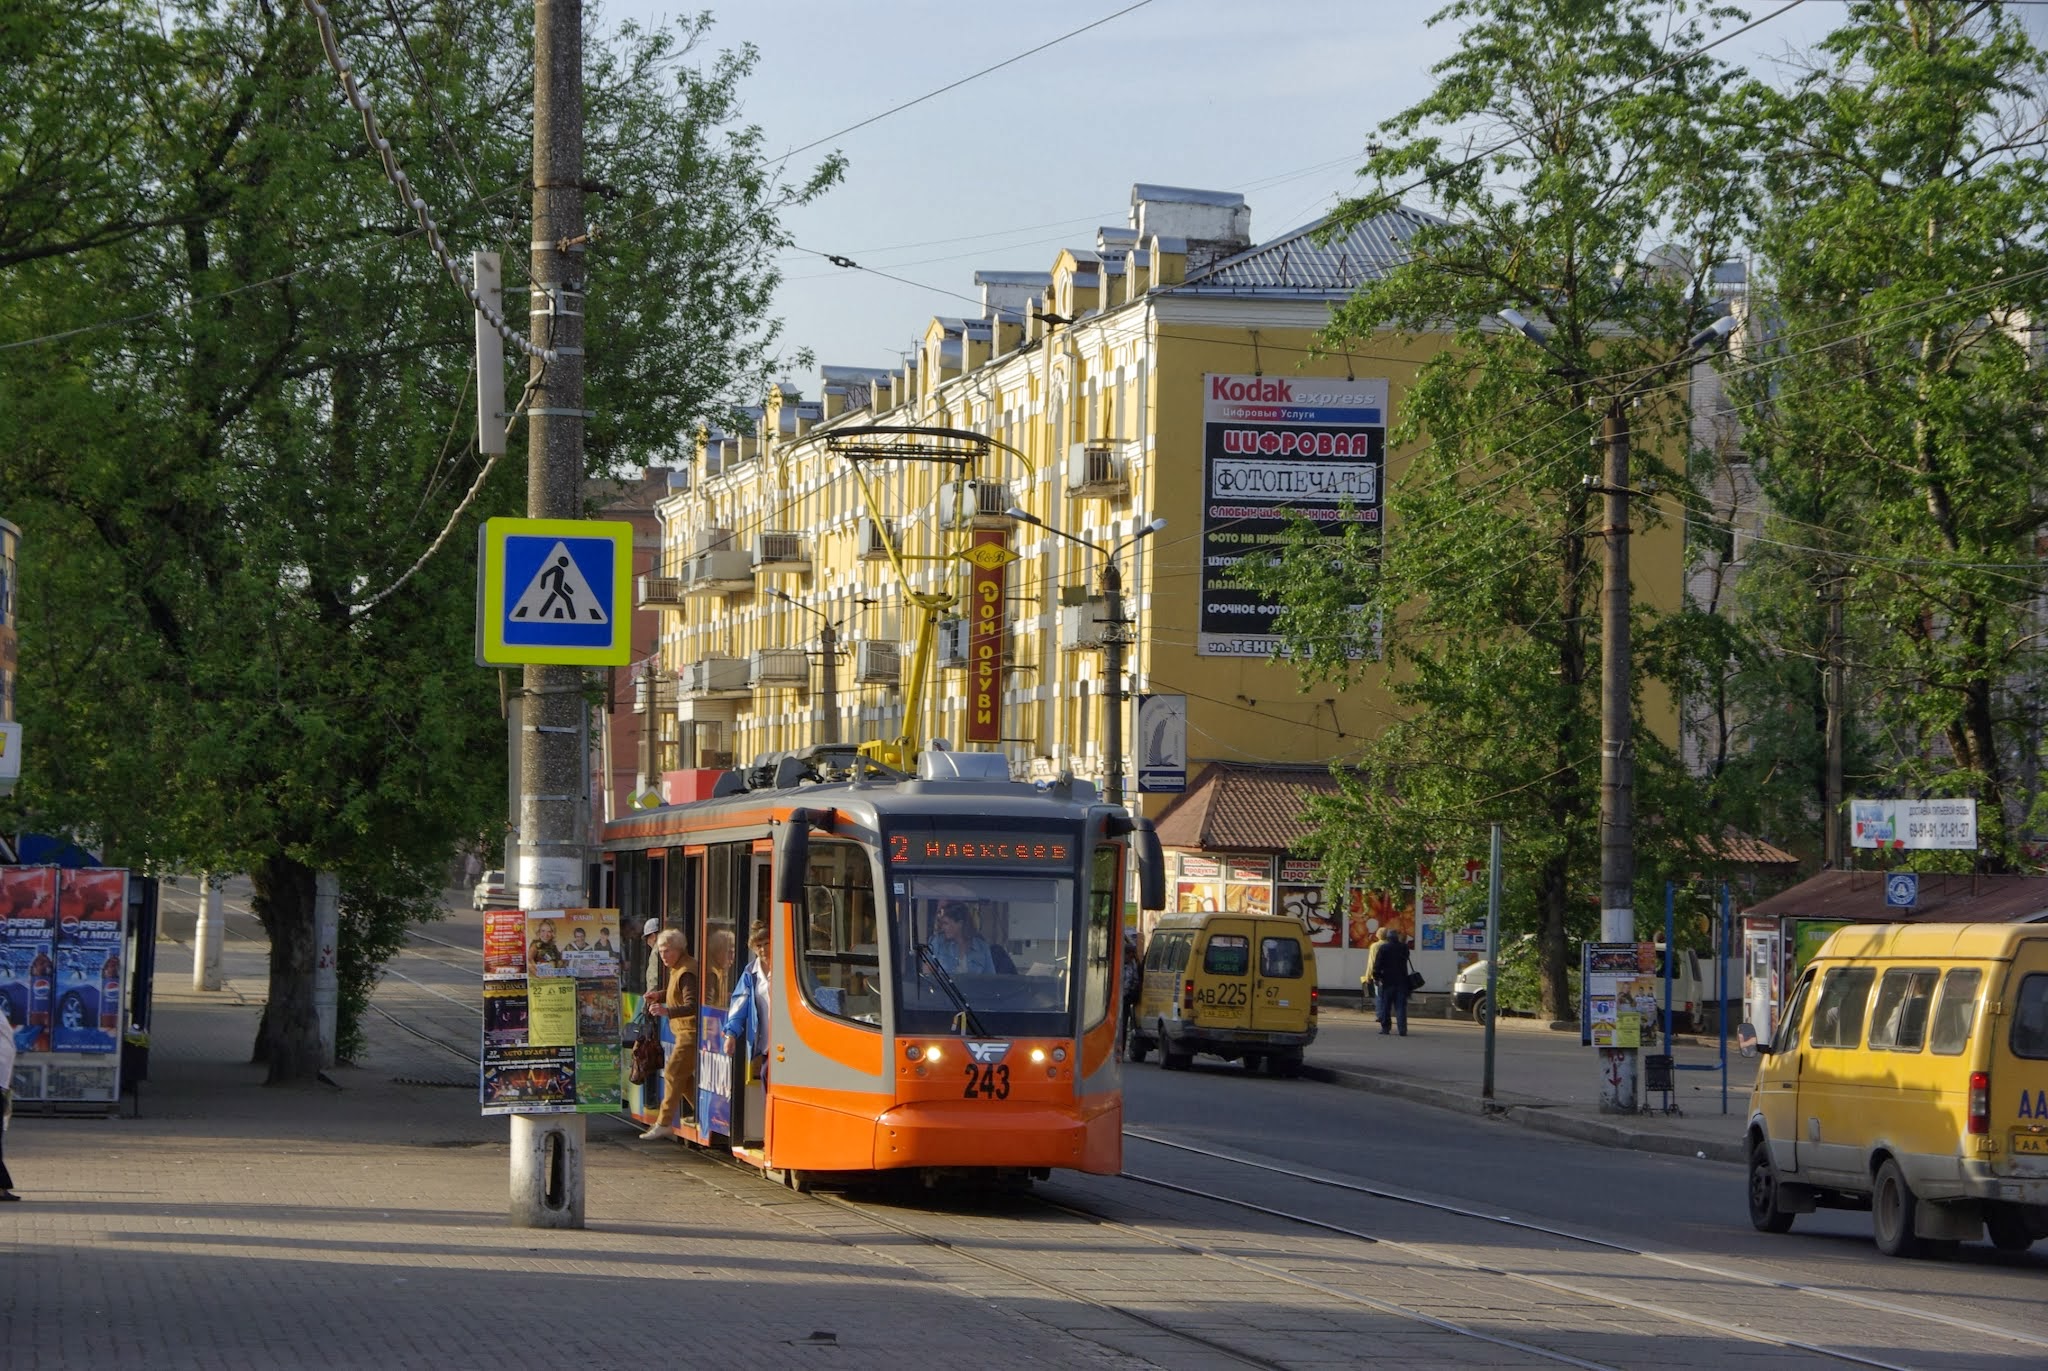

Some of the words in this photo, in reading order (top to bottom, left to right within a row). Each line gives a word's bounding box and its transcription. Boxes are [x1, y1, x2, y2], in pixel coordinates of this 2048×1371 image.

[1212, 376, 1293, 403] Kodak
[1294, 391, 1376, 406] express
[1223, 408, 1278, 420] Цифровые
[1281, 409, 1315, 421] Услуги
[1223, 430, 1368, 457] ЦИФРОВАЯ
[1218, 469, 1371, 495] ФОТОПЕЧАТЬ
[1209, 505, 1217, 518] С
[1217, 506, 1258, 519] ЛЮБЫХ
[1208, 533, 1239, 543] ФОТО
[1241, 534, 1254, 544] НА
[978, 580, 999, 636] ДОМ
[1207, 603, 1256, 614] СРОЧНОЕ
[1257, 605, 1290, 615] ФОТО
[977, 645, 993, 725] ОБУВИ
[890, 835, 908, 862] 2
[7, 918, 46, 928] PEPSI
[80, 921, 118, 930] PEPSI
[533, 987, 542, 995] 22
[1266, 986, 1279, 998] 67
[963, 1063, 1010, 1100] 243
